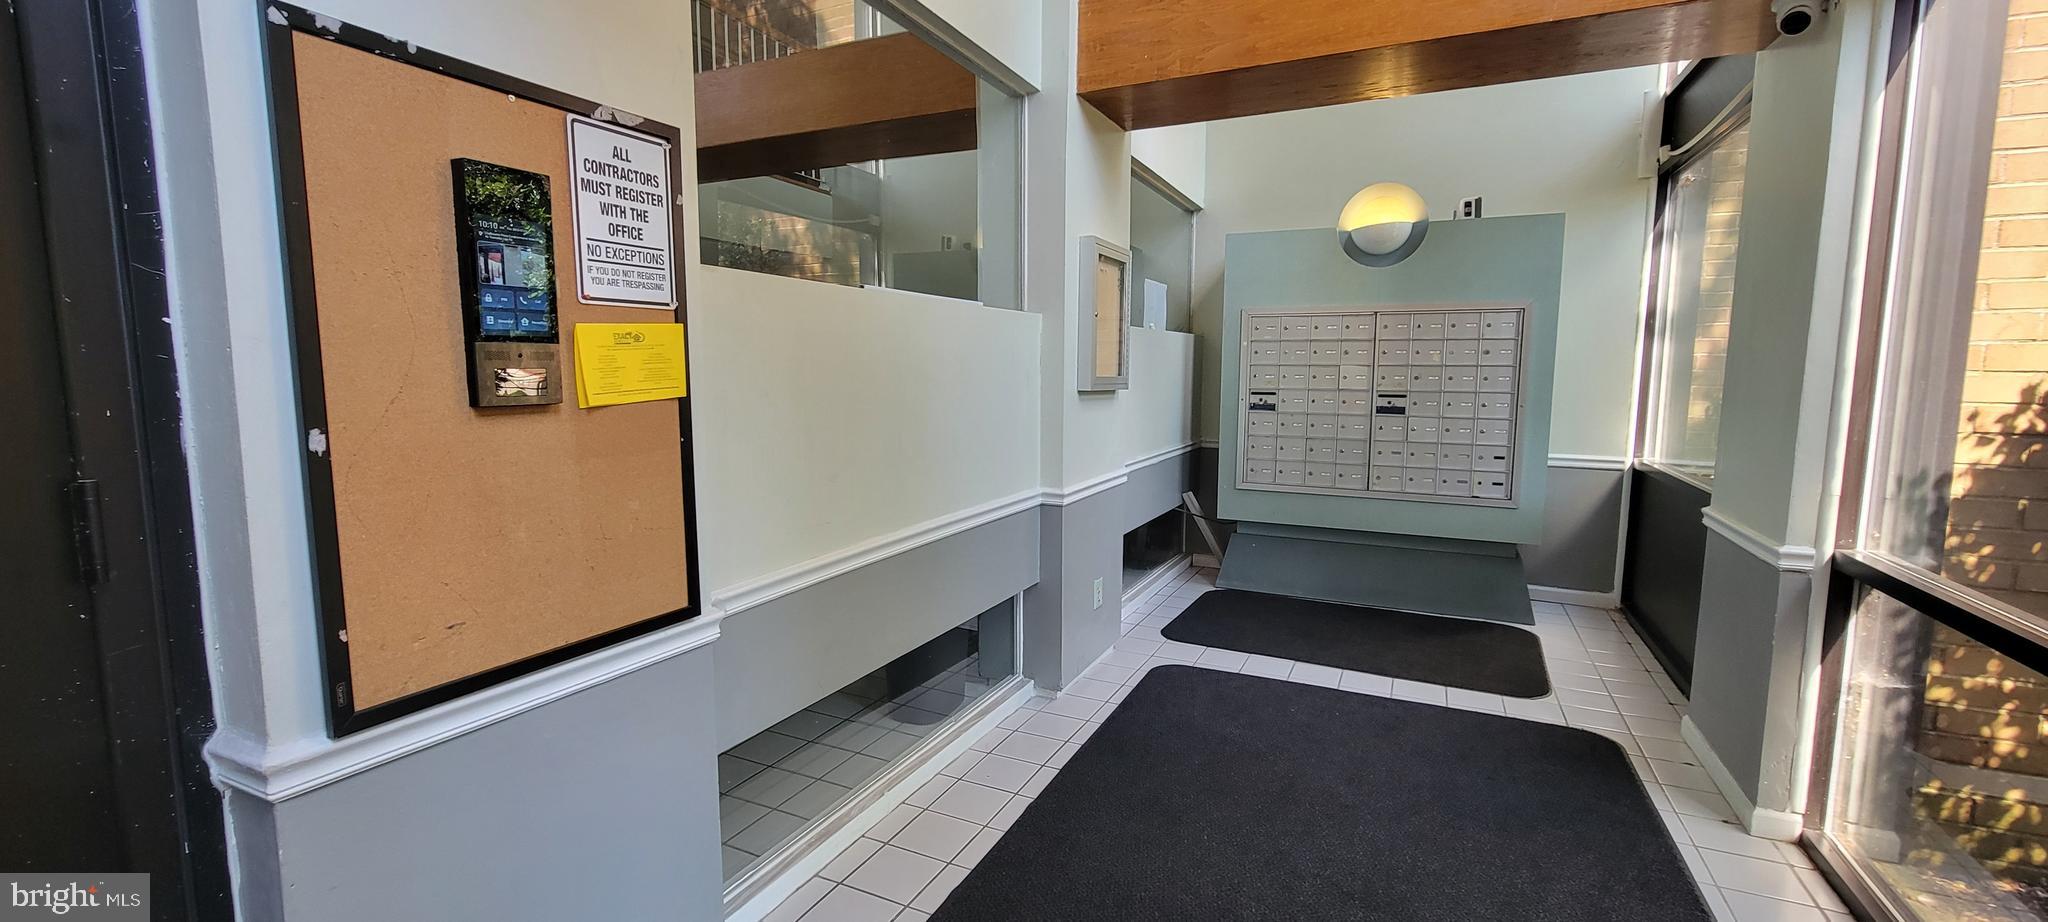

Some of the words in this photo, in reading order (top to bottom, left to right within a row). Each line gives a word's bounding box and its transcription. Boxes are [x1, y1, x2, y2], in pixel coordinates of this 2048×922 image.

[612, 146, 632, 163] ALL
[583, 158, 660, 188] CONTRACTORS
[580, 177, 612, 197] MUST
[615, 185, 664, 208] REGISTER
[599, 202, 627, 219] WITH
[630, 208, 649, 223] THE
[479, 220, 498, 229] 10:10
[608, 222, 644, 241] OFFICE
[587, 243, 602, 257] NO
[605, 246, 665, 265] EXCEPTIONS
[587, 265, 593, 274] IF
[595, 266, 609, 276] YOU
[611, 268, 621, 277] DO
[622, 270, 635, 279] NOT
[637, 271, 666, 282] REGISTER
[590, 276, 605, 285] YOU
[606, 278, 620, 287] ARE
[622, 279, 665, 291] TRESPASSING
